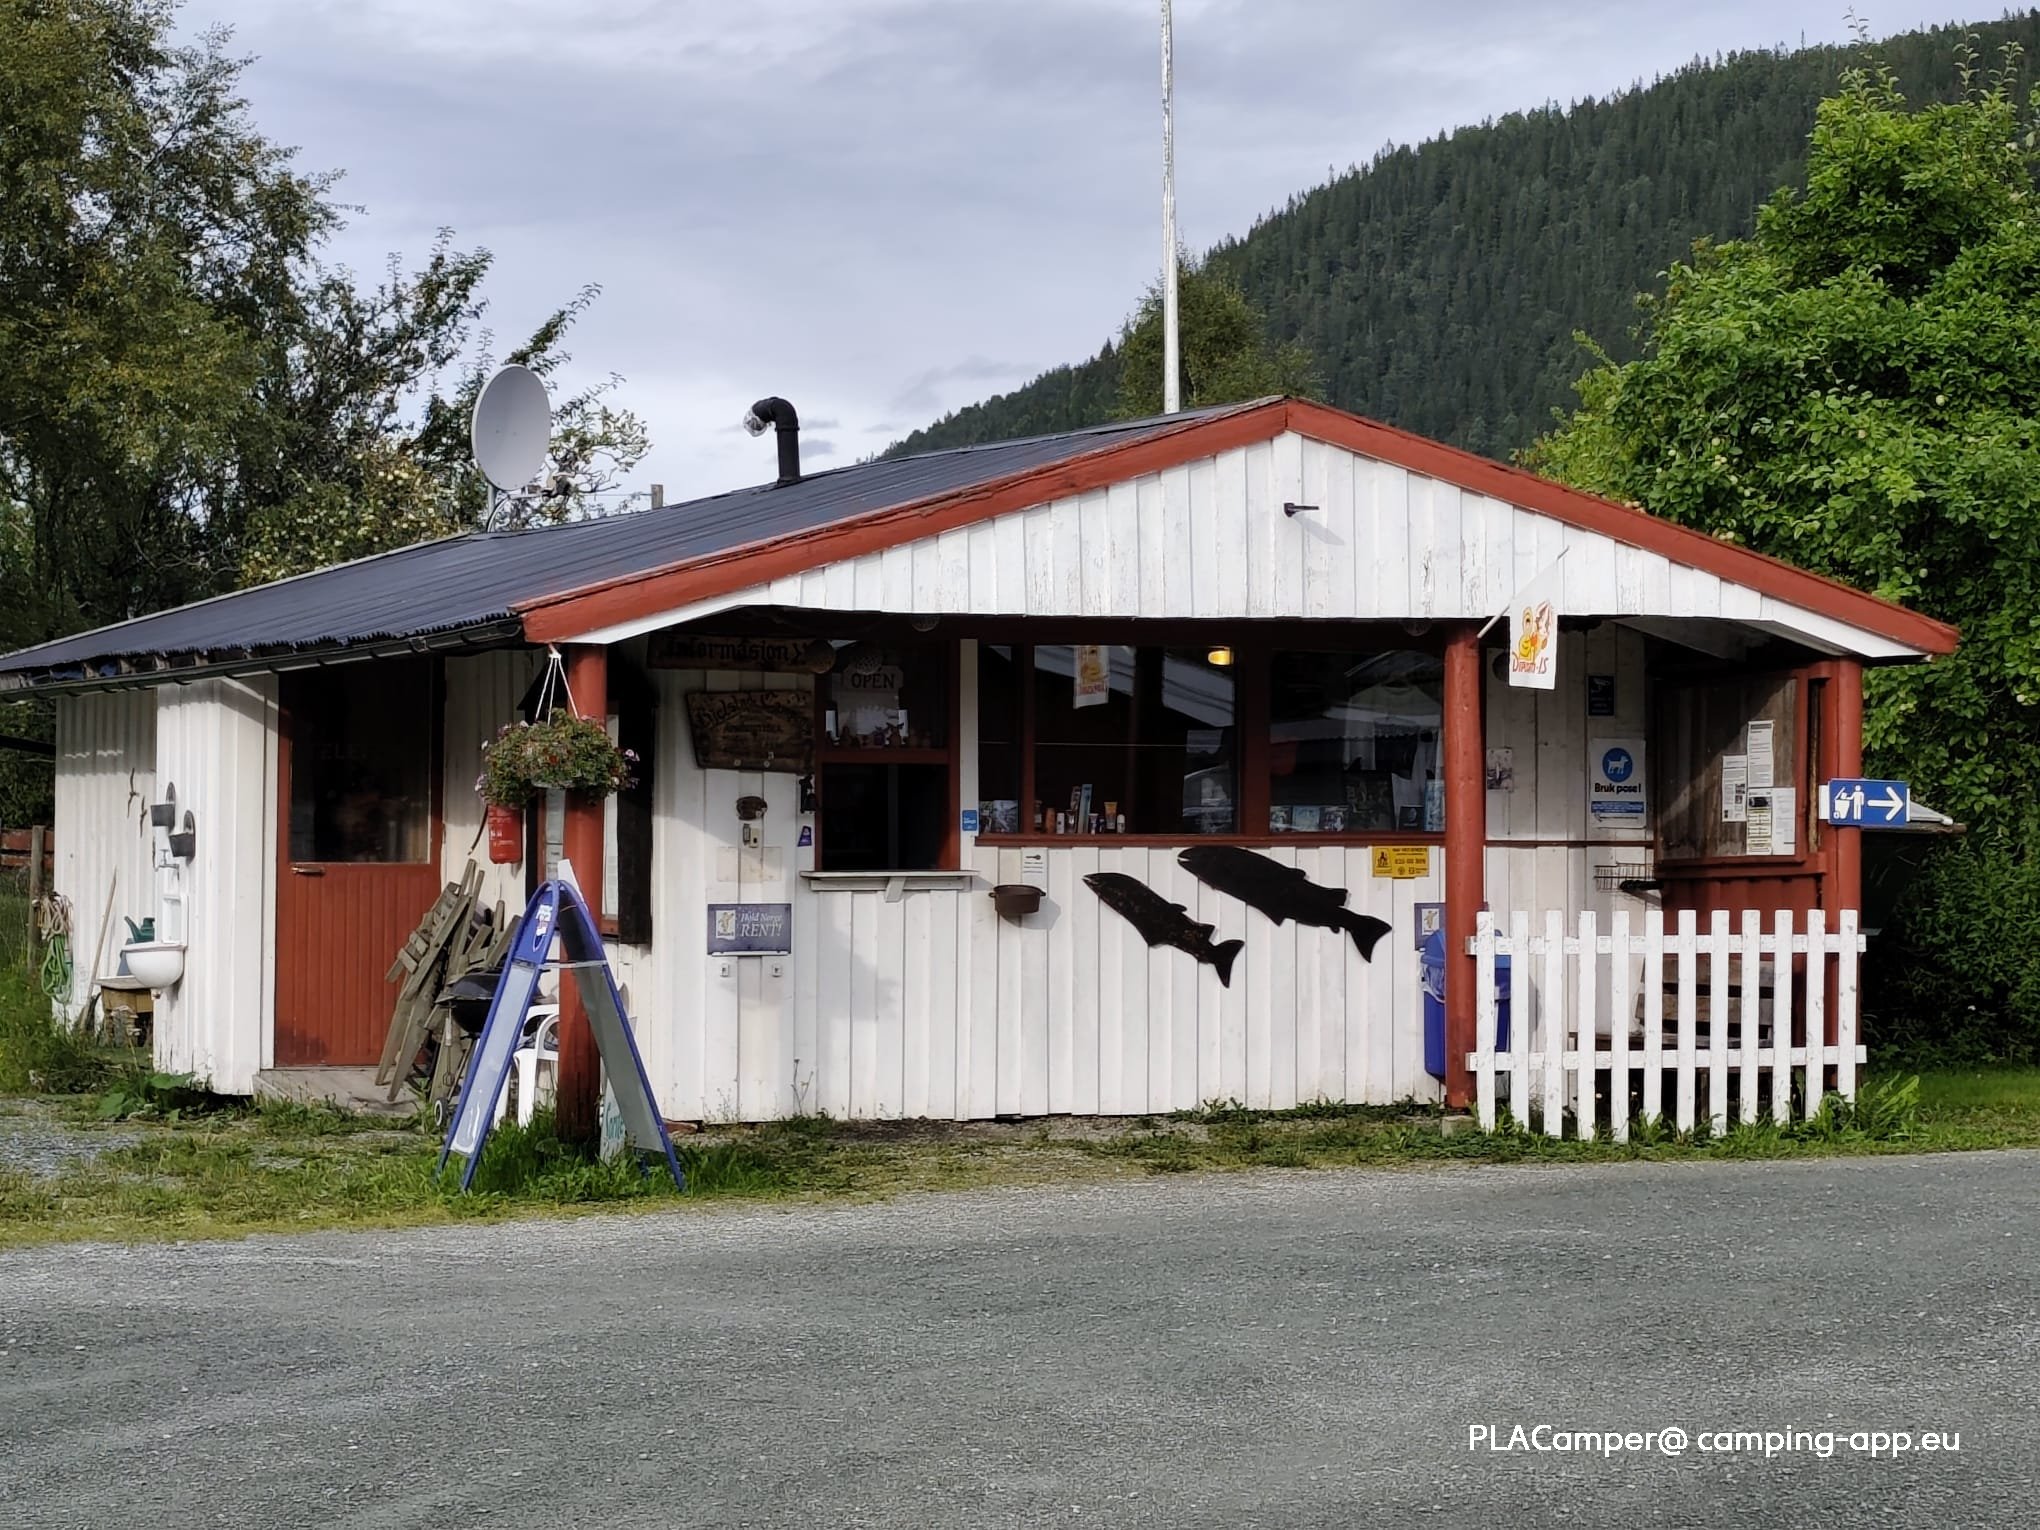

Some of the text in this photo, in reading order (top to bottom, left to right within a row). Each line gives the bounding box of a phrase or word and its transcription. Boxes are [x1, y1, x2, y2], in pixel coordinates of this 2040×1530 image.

[851, 672, 895, 689] OPEN
[1594, 783, 1641, 795] Bruk pose!
[740, 922, 782, 937] RENT!
